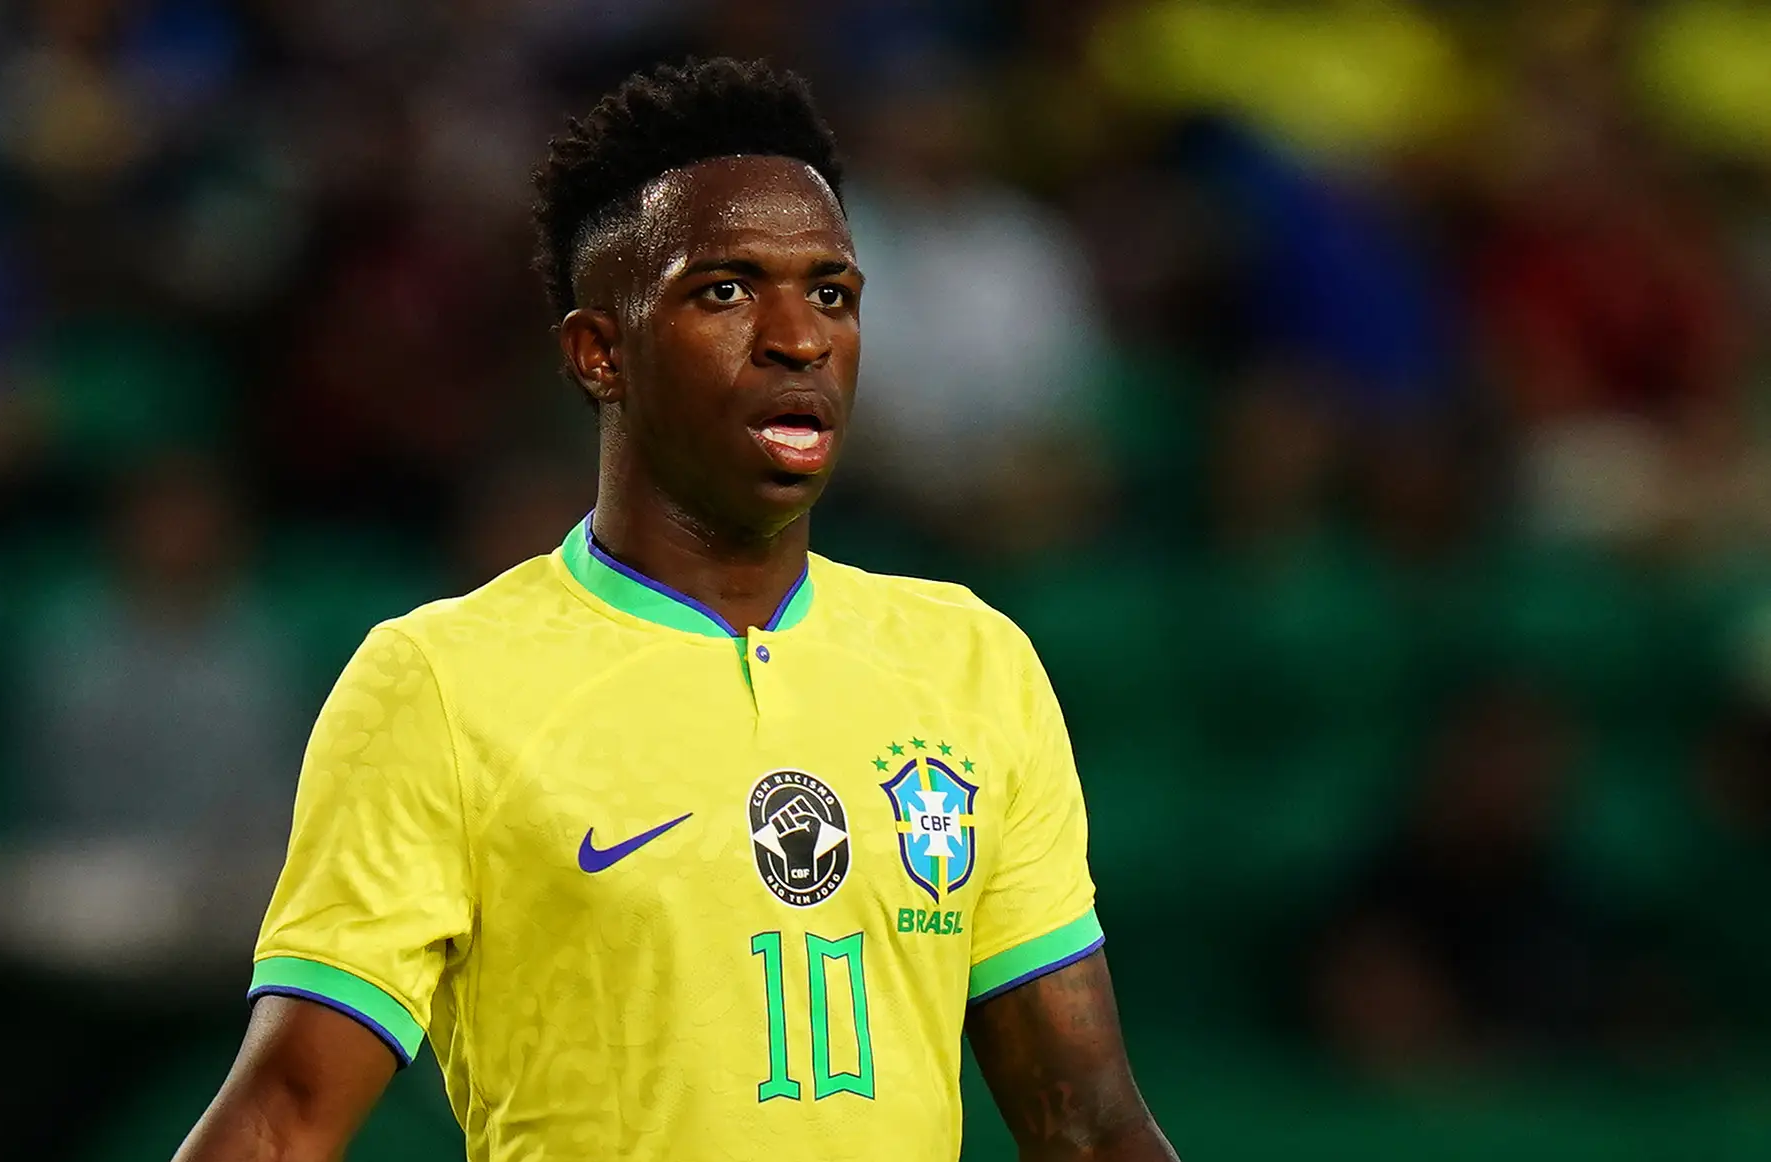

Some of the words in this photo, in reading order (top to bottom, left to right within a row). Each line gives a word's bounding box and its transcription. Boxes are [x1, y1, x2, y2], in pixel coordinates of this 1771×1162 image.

[773, 774, 835, 805] RACISMO
[920, 814, 952, 832] CBF
[750, 930, 876, 1103] 10
